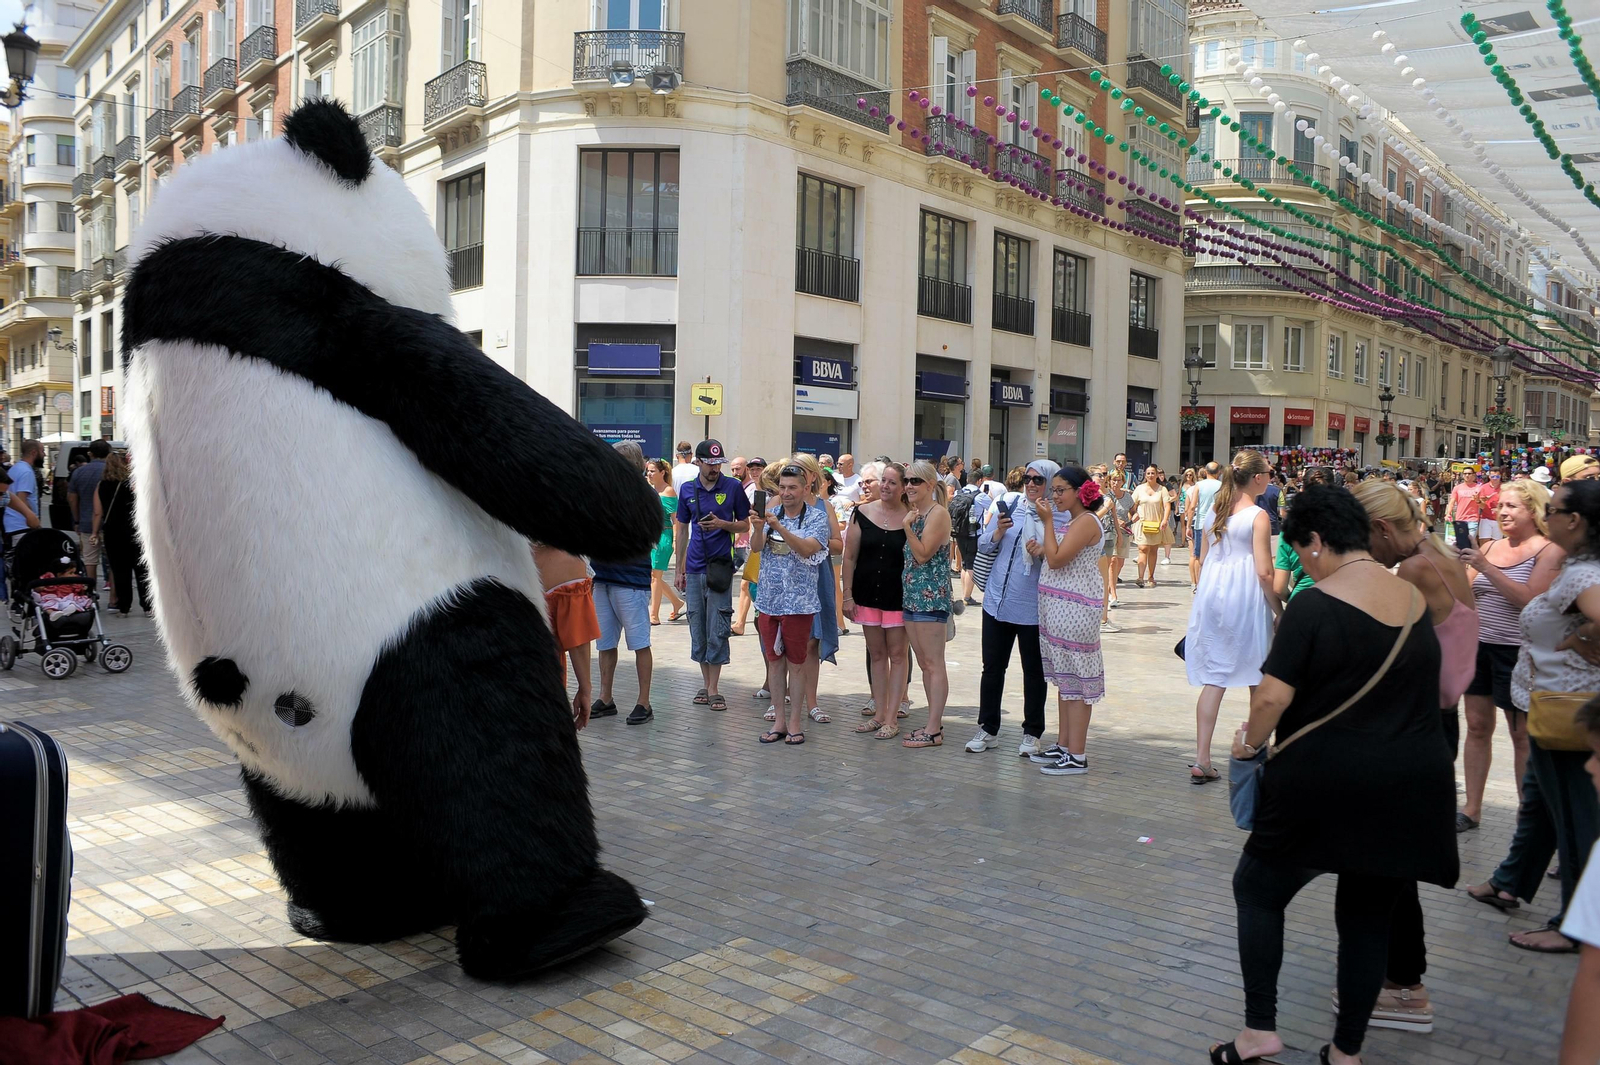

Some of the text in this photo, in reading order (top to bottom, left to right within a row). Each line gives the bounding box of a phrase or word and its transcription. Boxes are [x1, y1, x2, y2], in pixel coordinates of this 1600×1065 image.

[812, 360, 843, 380] BBVA
[1002, 385, 1024, 401] BBVA
[1134, 401, 1150, 415] BBVA
